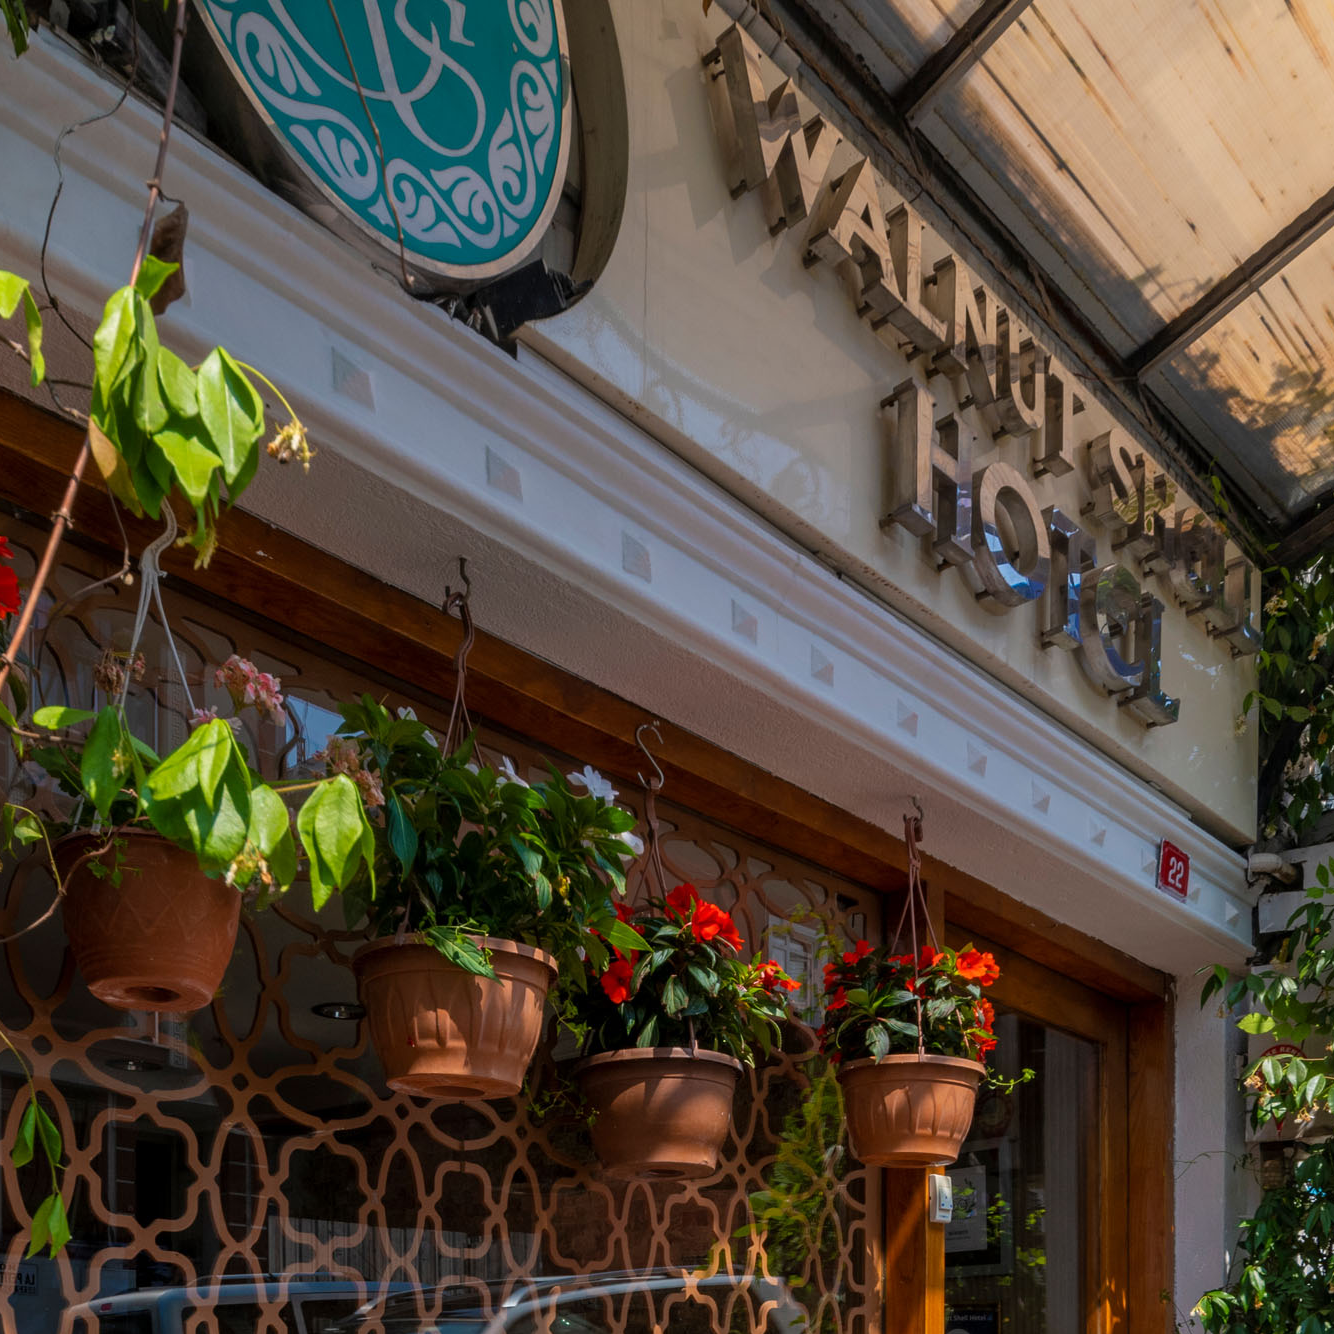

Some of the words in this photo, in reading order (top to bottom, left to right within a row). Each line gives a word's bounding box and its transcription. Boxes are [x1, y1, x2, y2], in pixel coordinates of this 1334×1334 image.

[701, 22, 1083, 478] WALNUT
[879, 377, 1180, 727] HOTEL
[1168, 856, 1184, 889] 22
